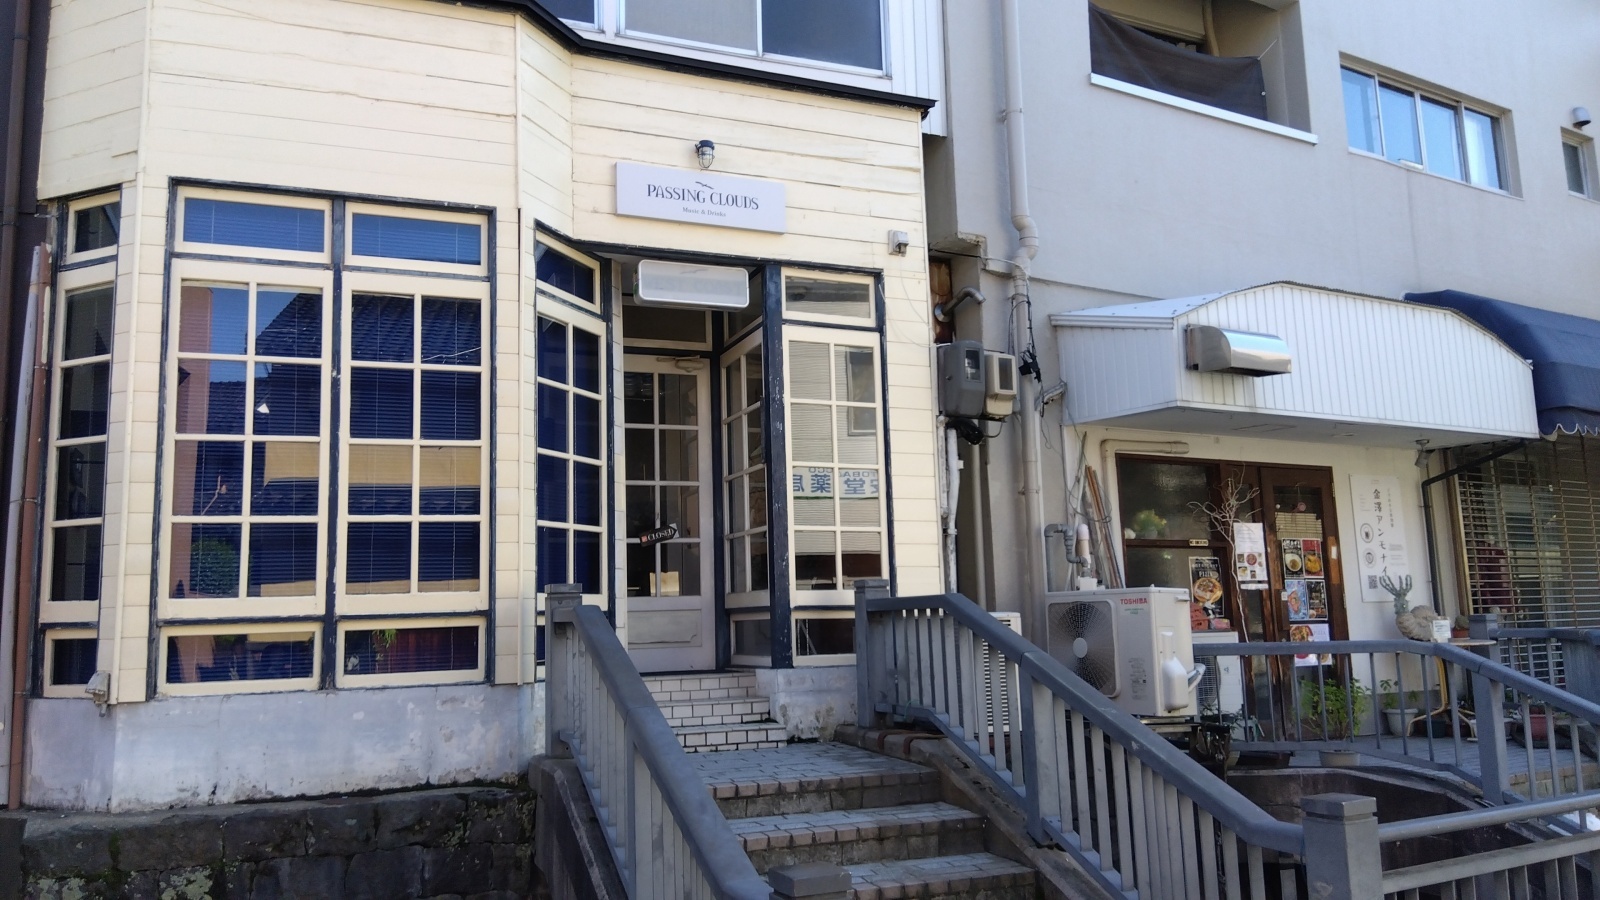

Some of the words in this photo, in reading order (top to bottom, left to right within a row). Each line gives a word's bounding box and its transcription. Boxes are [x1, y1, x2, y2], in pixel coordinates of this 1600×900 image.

[647, 184, 706, 203] PASSING
[710, 192, 759, 210] CLOUDS
[682, 206, 699, 215] Music
[707, 209, 726, 217] Drinks
[647, 528, 675, 541] CLOSED
[1372, 488, 1388, 579] 金澤アンモナイ
[1120, 597, 1147, 605] TOSHIBA
